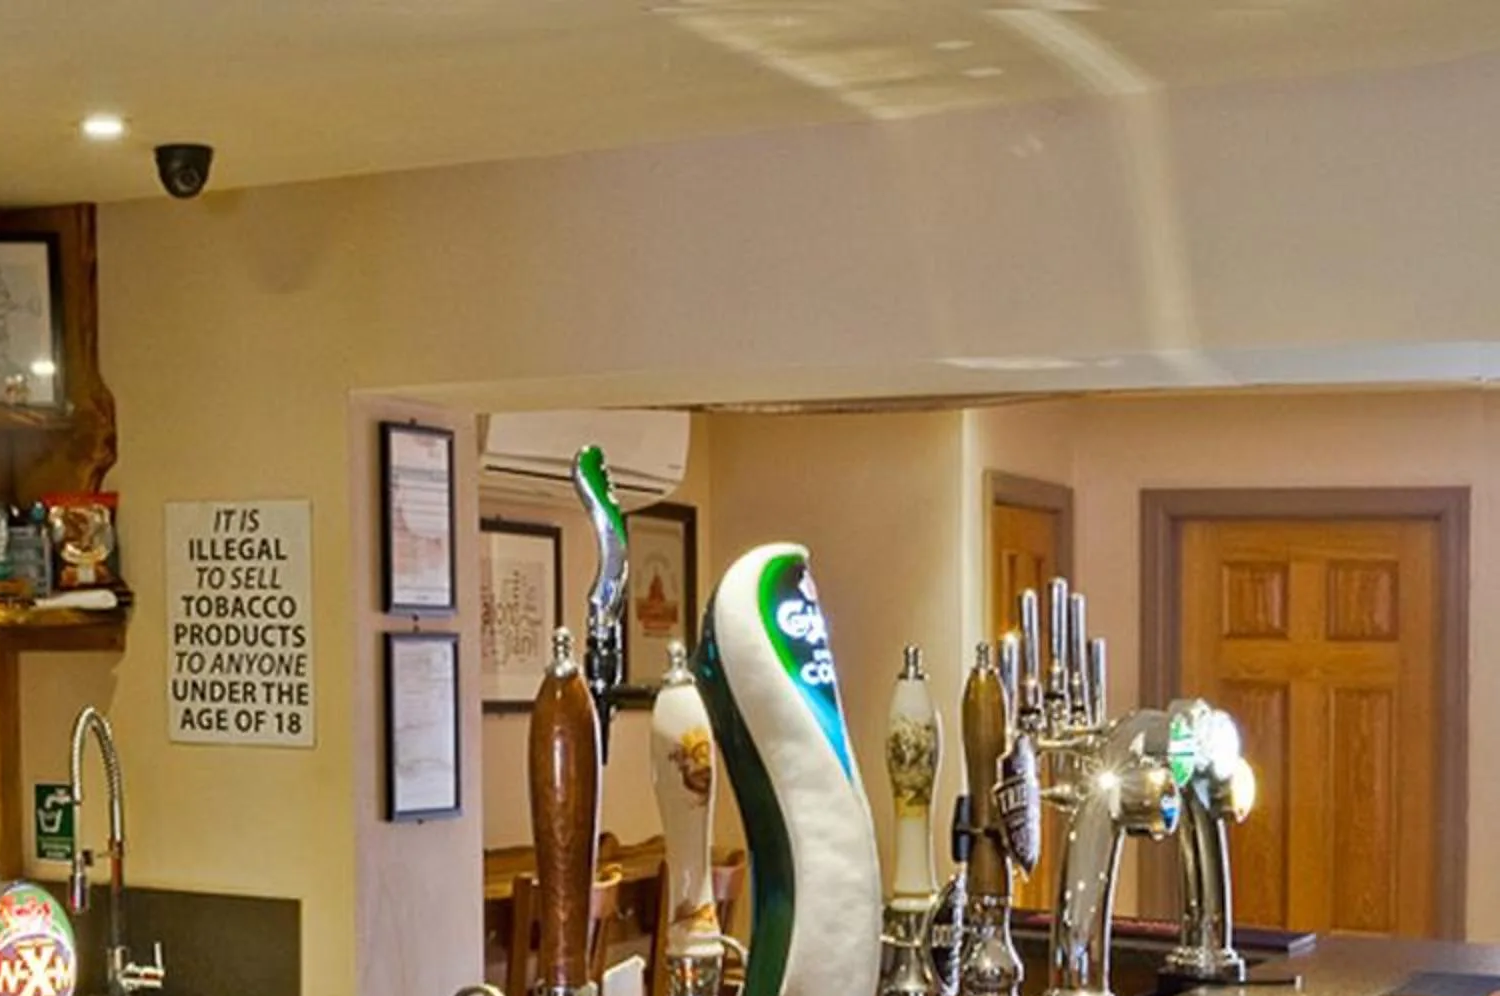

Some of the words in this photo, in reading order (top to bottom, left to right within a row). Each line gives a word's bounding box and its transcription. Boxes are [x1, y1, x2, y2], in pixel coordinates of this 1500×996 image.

[214, 509, 236, 533] IT
[239, 508, 260, 533] IS
[189, 538, 287, 561] ILLEGAL
[196, 567, 225, 590] TO
[230, 567, 281, 590] SELL
[181, 596, 297, 619] TOBACCO
[174, 623, 306, 648] PRODUCTS
[175, 652, 206, 675] TO
[210, 653, 308, 677] ANYONE
[171, 680, 256, 704] UNDER
[261, 682, 309, 706] THE
[180, 708, 228, 731] AGE
[234, 710, 266, 732] OF
[274, 712, 302, 735] 18
